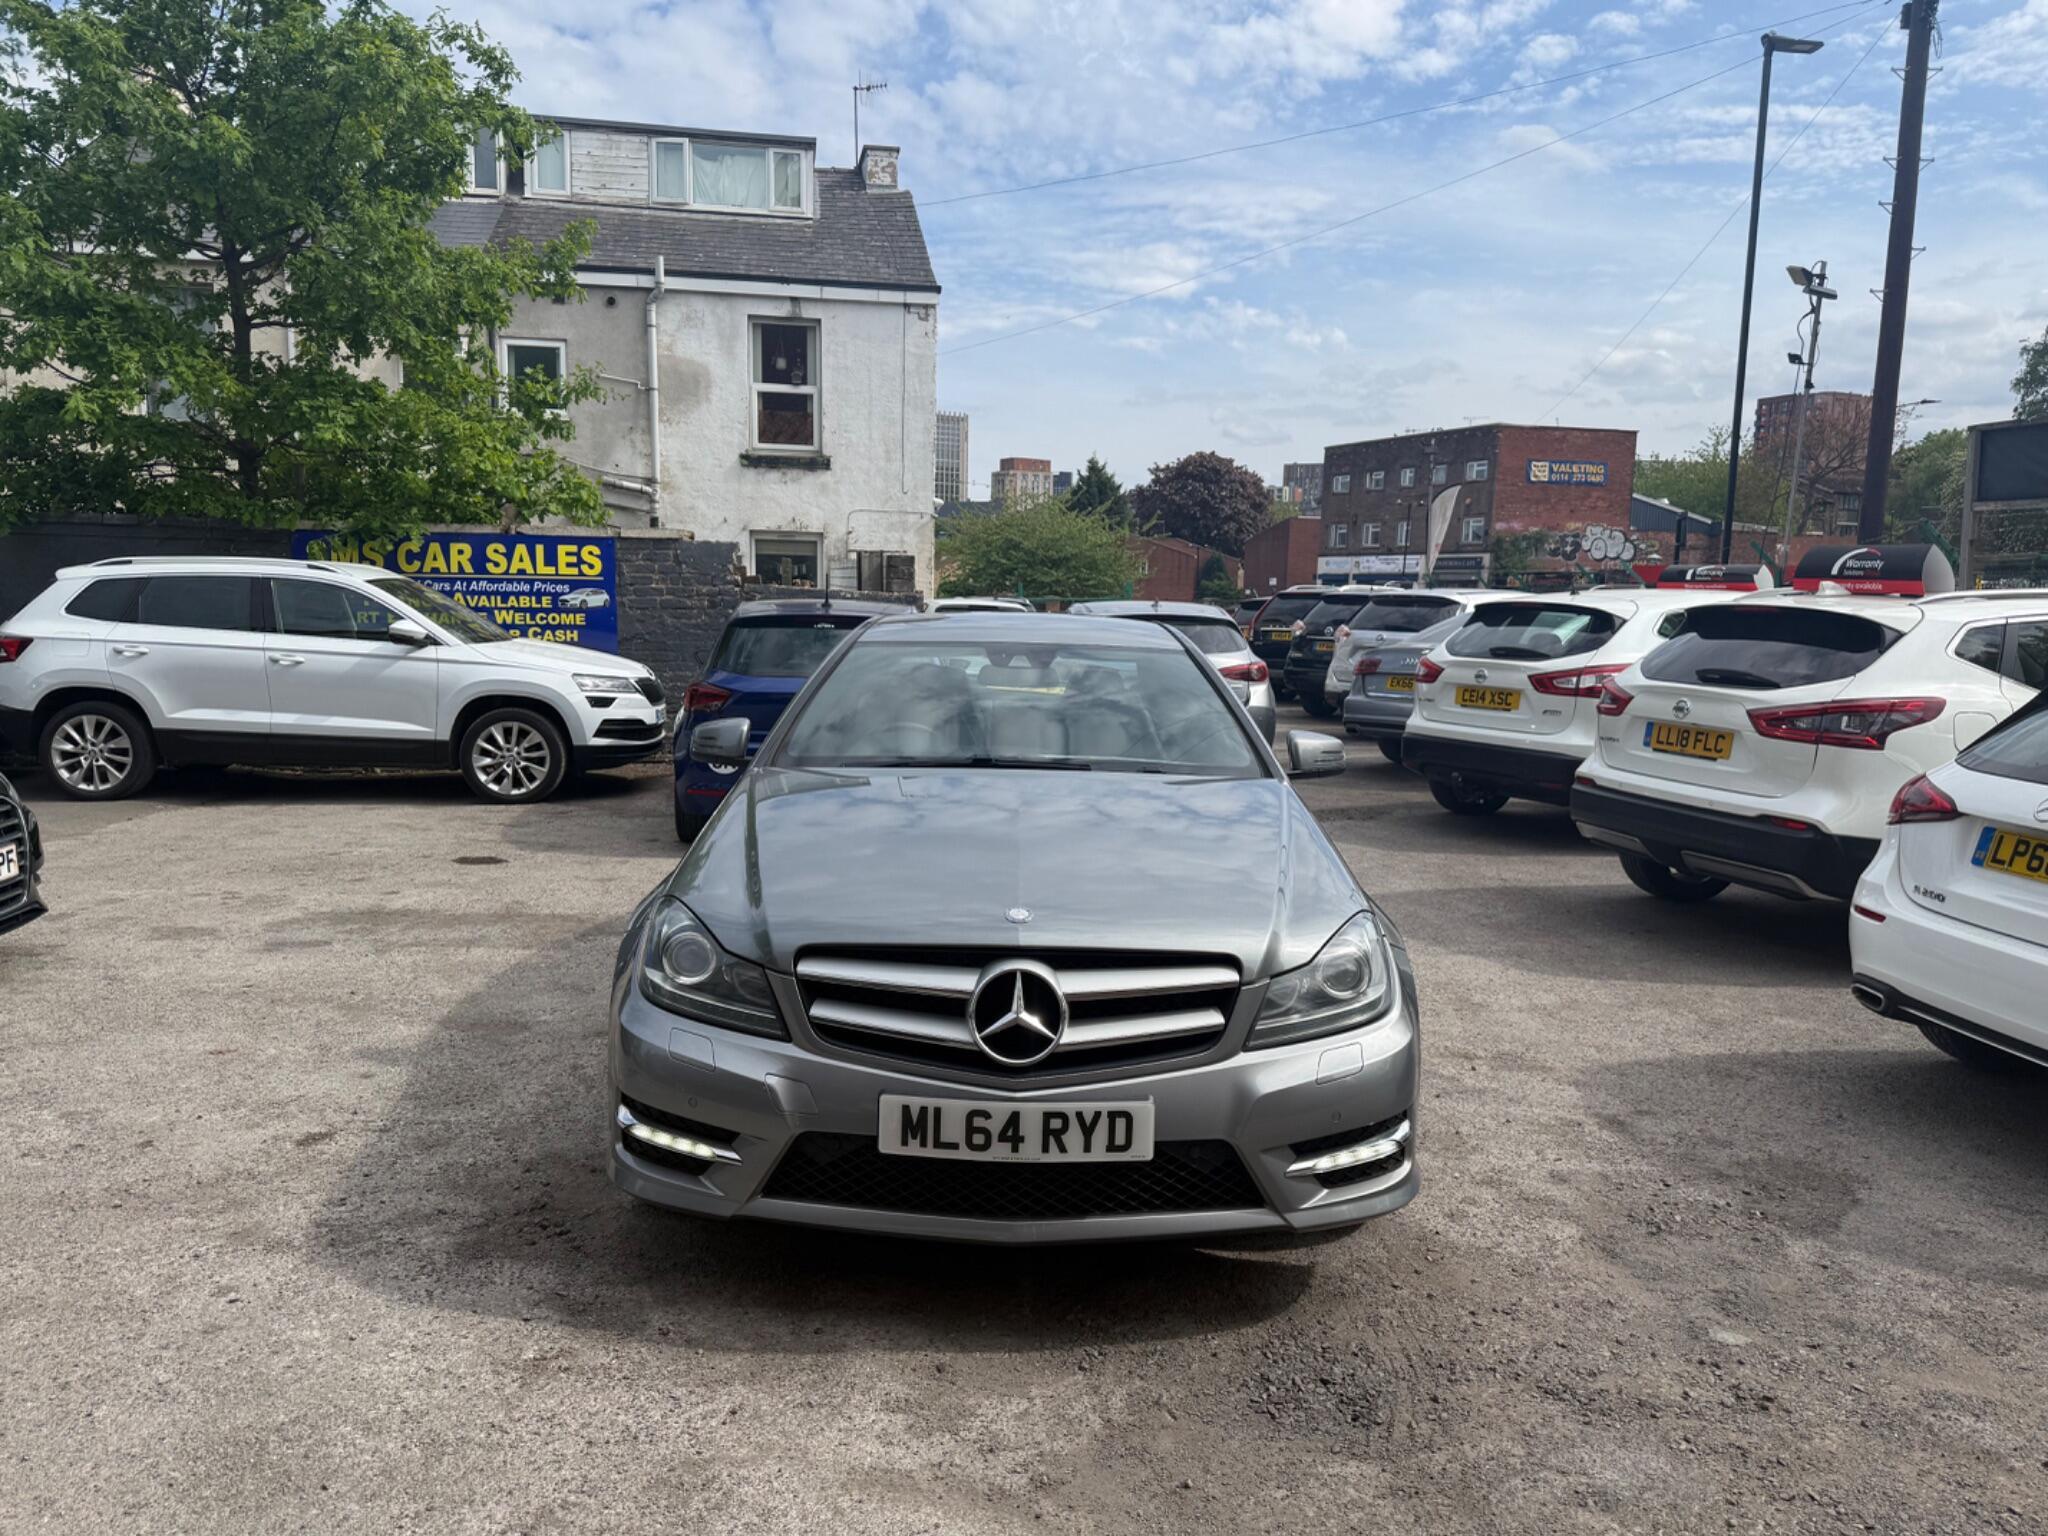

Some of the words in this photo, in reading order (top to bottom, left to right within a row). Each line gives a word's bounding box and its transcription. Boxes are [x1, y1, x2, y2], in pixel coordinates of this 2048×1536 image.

[1552, 463, 1605, 474] VALETING
[307, 539, 384, 568] MS
[397, 541, 474, 573] CAR
[485, 543, 602, 576] SALES
[1846, 559, 1884, 570] Warranty
[423, 580, 451, 592] Cars
[453, 580, 467, 592] At
[469, 580, 530, 593] Affordable
[533, 582, 570, 594] Prices
[453, 592, 553, 608] AVAILABLE
[495, 610, 586, 625] WELCOME
[528, 627, 579, 642] CASH
[1462, 688, 1486, 703] CE14
[1489, 690, 1513, 707] XSC
[1656, 724, 1690, 748] LL18
[1693, 731, 1726, 754] FLC
[1990, 834, 2048, 876] LP6
[901, 1104, 1025, 1153] ML64
[1041, 1110, 1134, 1154] RYD
